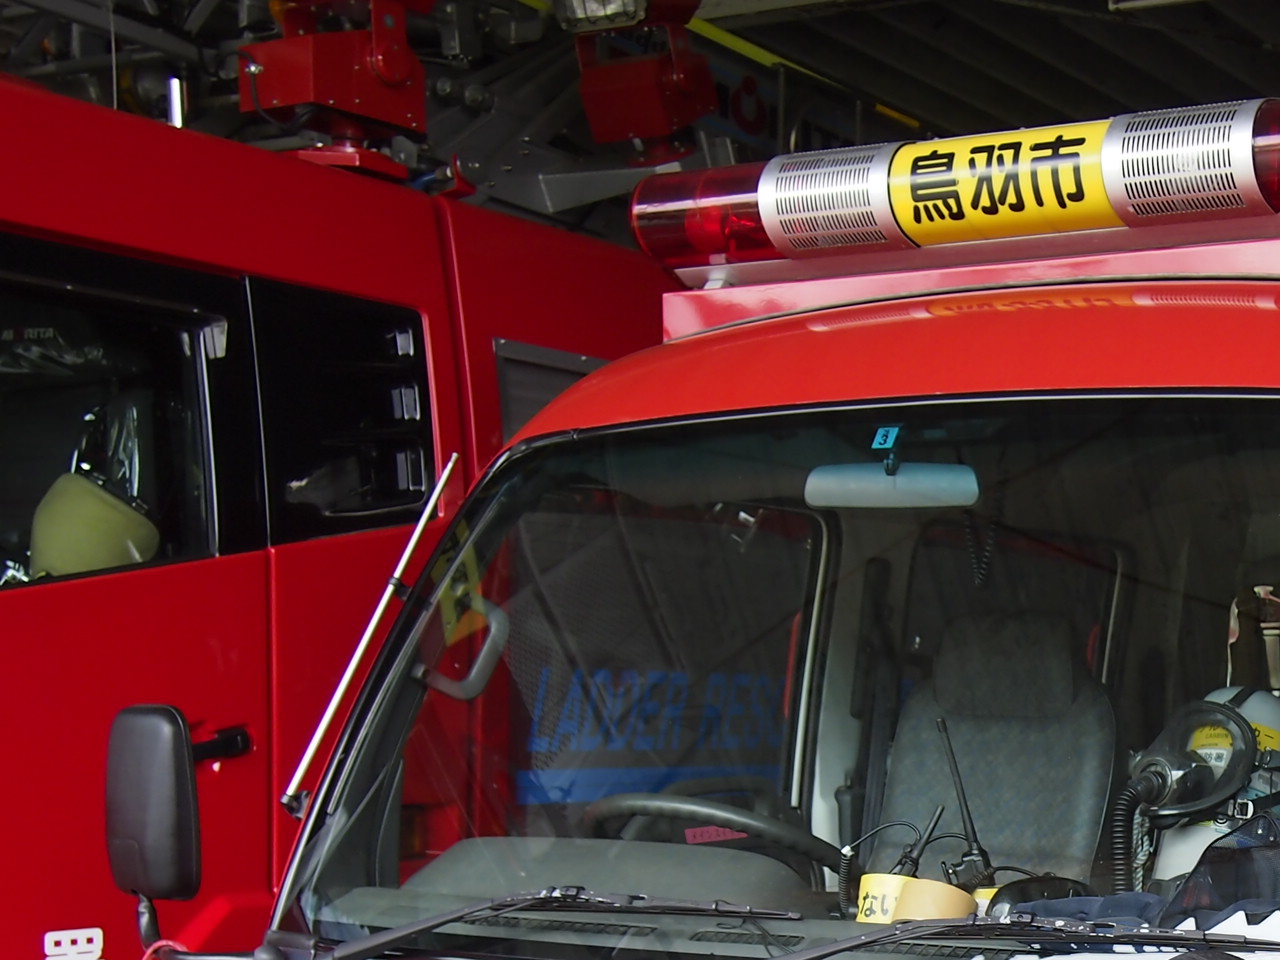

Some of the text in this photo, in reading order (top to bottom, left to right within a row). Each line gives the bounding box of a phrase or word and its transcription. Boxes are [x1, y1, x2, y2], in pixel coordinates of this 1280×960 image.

[909, 134, 1087, 225] 鳥羽市
[528, 667, 690, 751] LADDER
